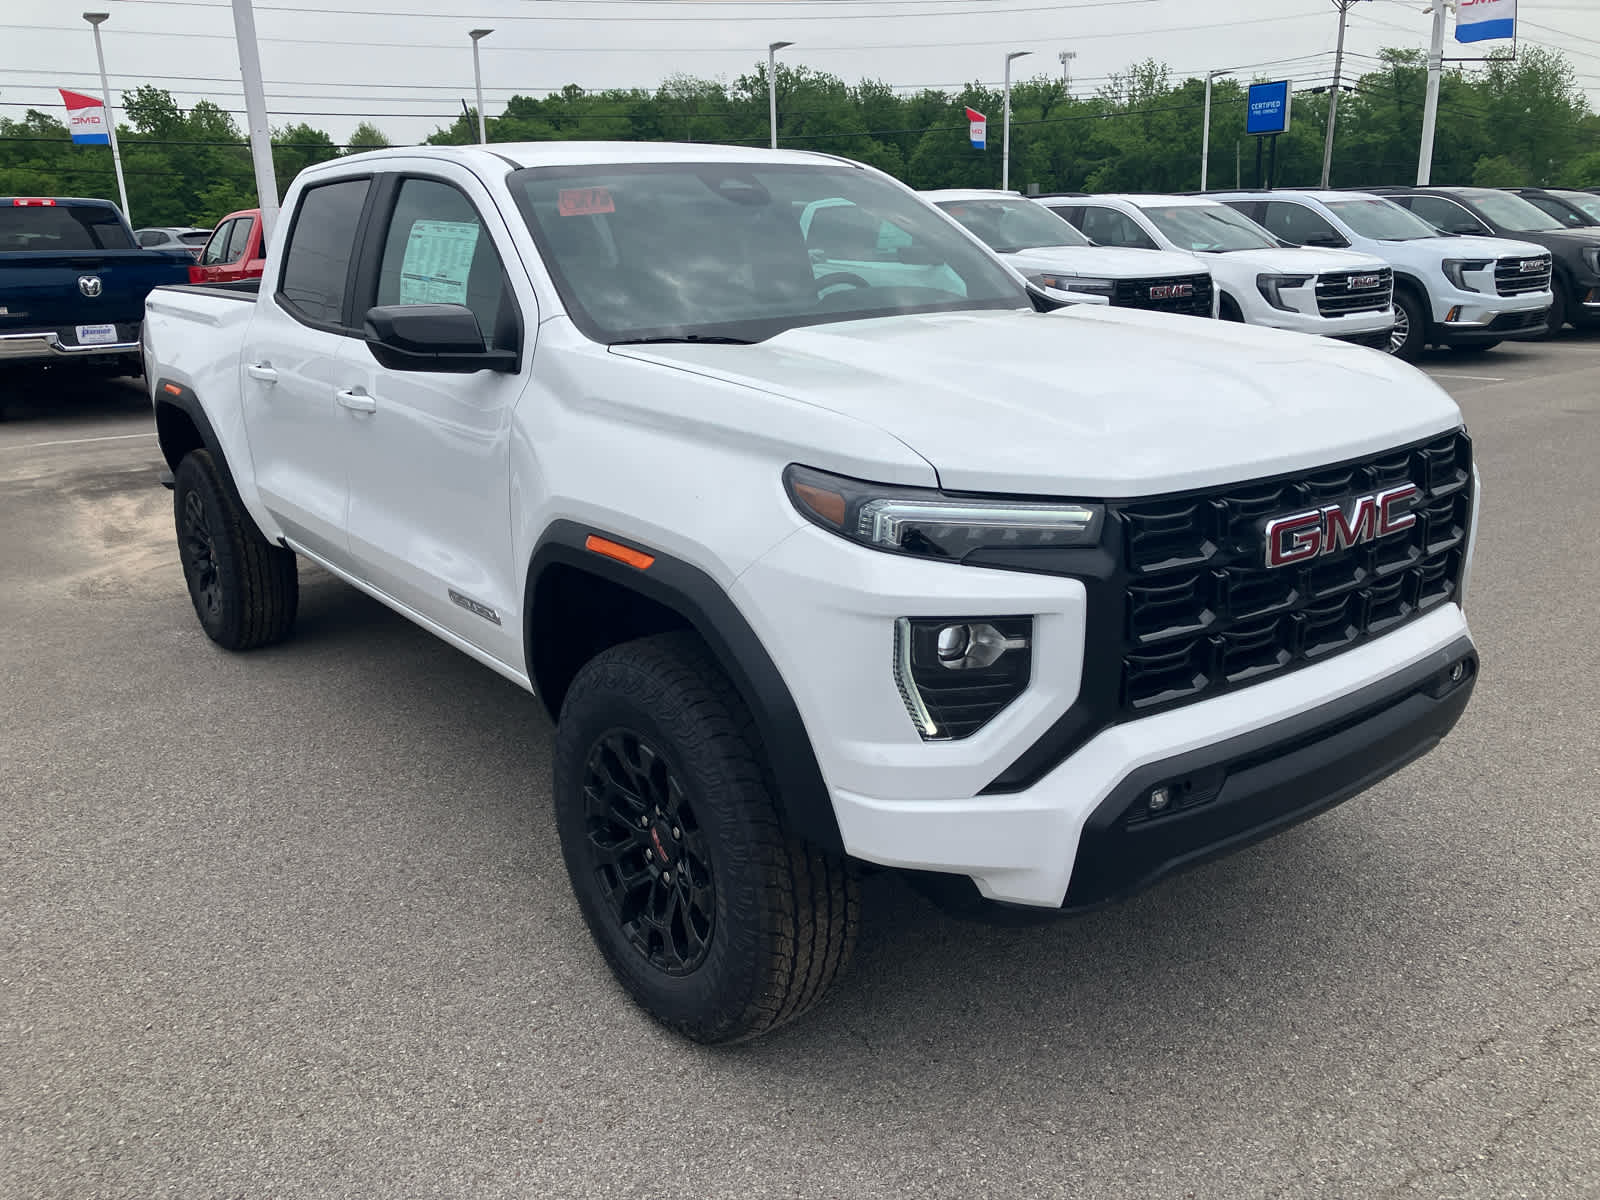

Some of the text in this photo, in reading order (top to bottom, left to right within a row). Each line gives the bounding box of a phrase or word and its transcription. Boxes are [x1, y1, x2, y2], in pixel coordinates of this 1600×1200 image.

[1251, 101, 1281, 110] CERTIFIED
[1149, 284, 1193, 299] GMC
[1265, 482, 1417, 569] GMC
